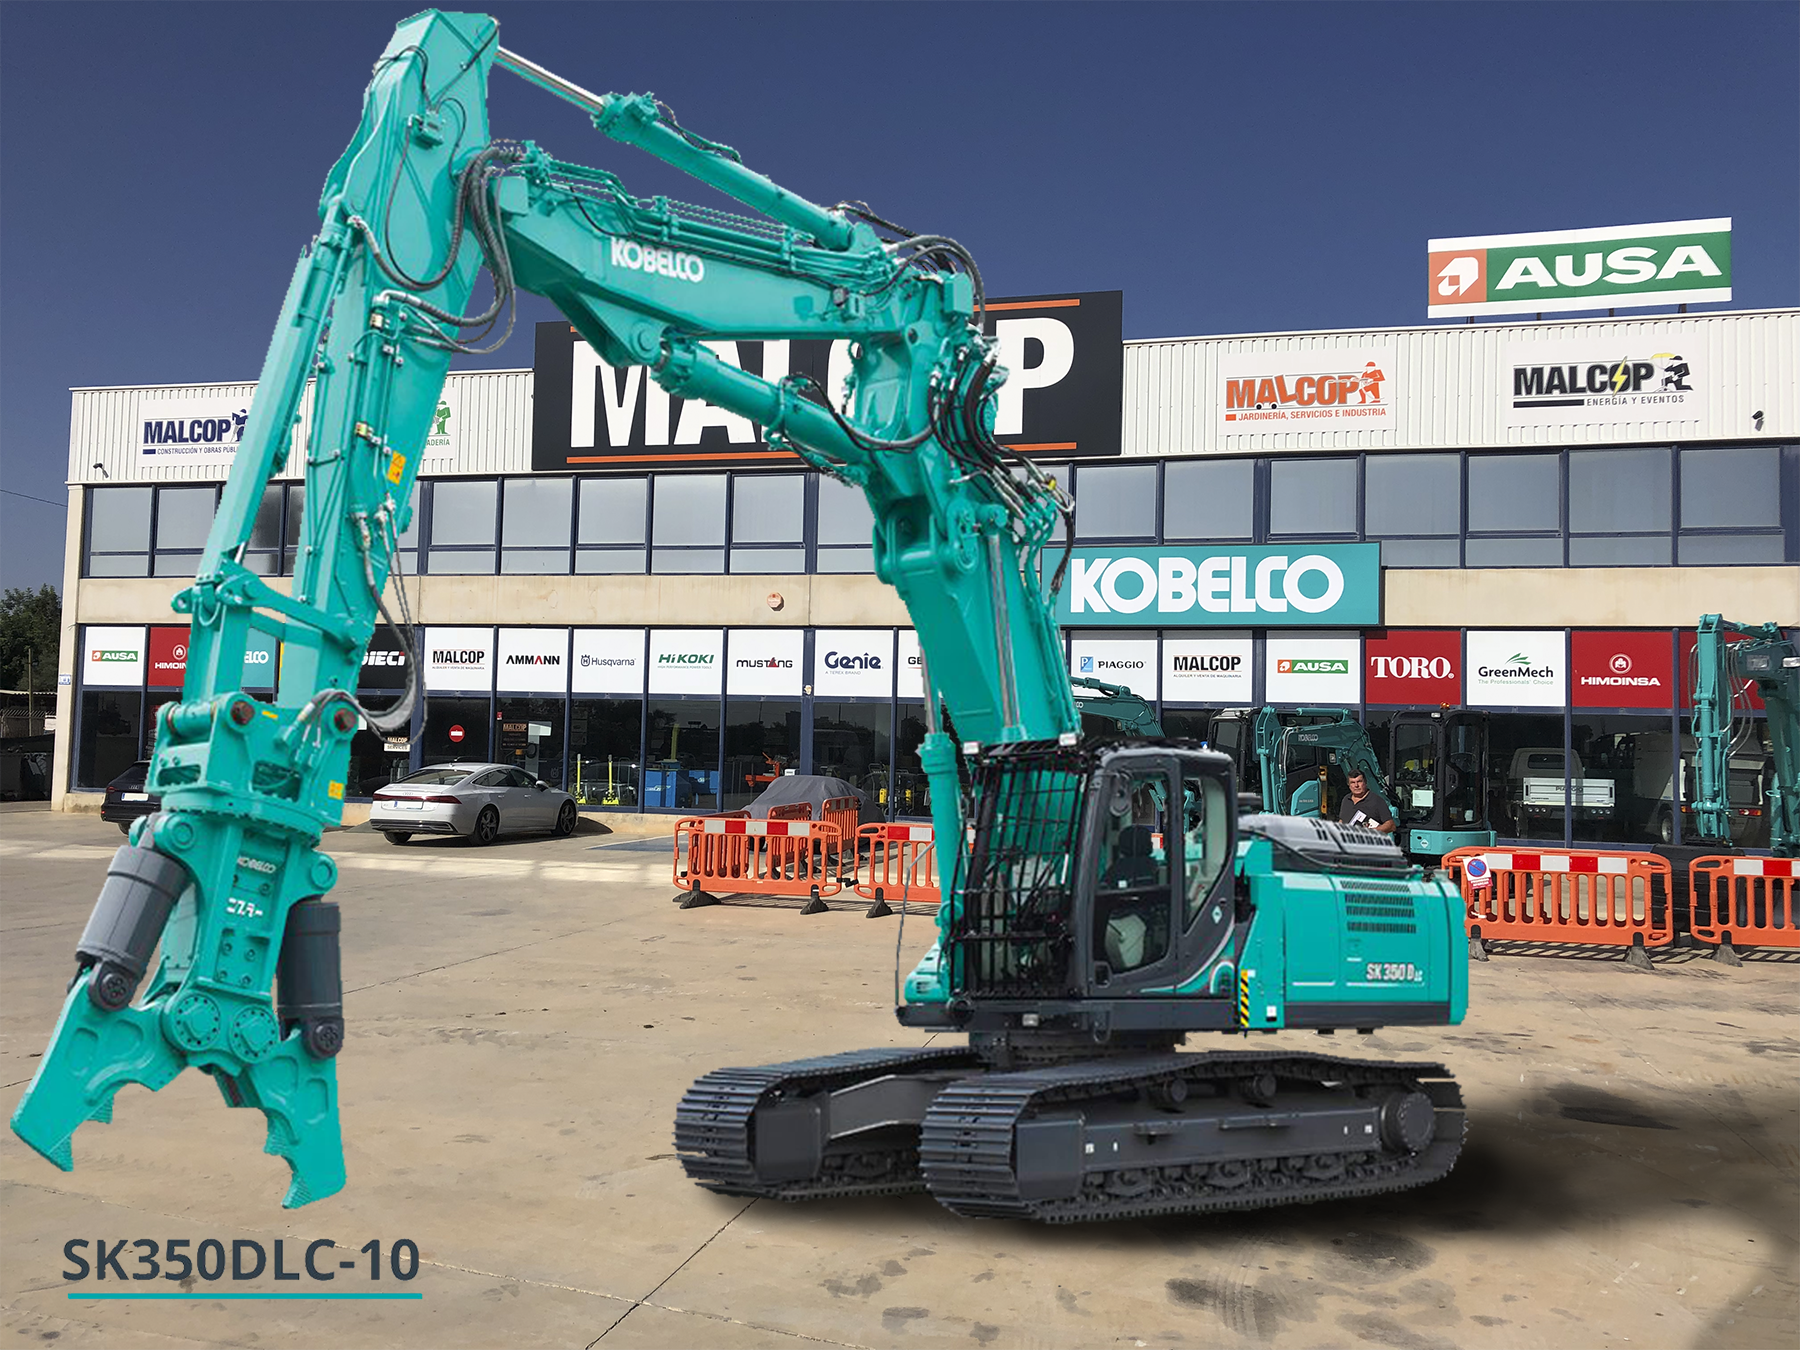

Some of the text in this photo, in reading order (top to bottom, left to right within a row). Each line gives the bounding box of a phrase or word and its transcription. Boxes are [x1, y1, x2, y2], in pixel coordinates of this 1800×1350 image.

[611, 236, 705, 282] KOBELCO
[1494, 244, 1722, 290] AUSA
[1513, 362, 1655, 397] MALCOP
[1226, 374, 1360, 409] MALCOP
[1586, 395, 1685, 406] ENERGÍA Y EVENTOS
[1238, 408, 1387, 421] JARDINERÍA, SERVICIOS E INDUSTRIA
[143, 419, 231, 444] MALCOP
[427, 437, 451, 446] ADERÍA
[157, 446, 198, 455] CONSTRUCCIÓN
[204, 446, 222, 454] OBRAS
[223, 445, 239, 453] PÚBLI
[1070, 554, 1345, 614] KOBELCO
[102, 652, 137, 660] AUSA
[243, 650, 269, 664] ELCO
[432, 650, 485, 664] MALCOP
[506, 655, 560, 665] AMMANN
[591, 657, 635, 667] Husqvarna
[824, 651, 882, 669] Genie
[1097, 660, 1145, 669] PIAGGIO
[1173, 656, 1242, 671] MALCOP
[1293, 661, 1346, 671] AUSA
[1370, 656, 1451, 678] TORO
[1478, 666, 1554, 678] GreenMech
[1580, 676, 1661, 686] HIMOINSA
